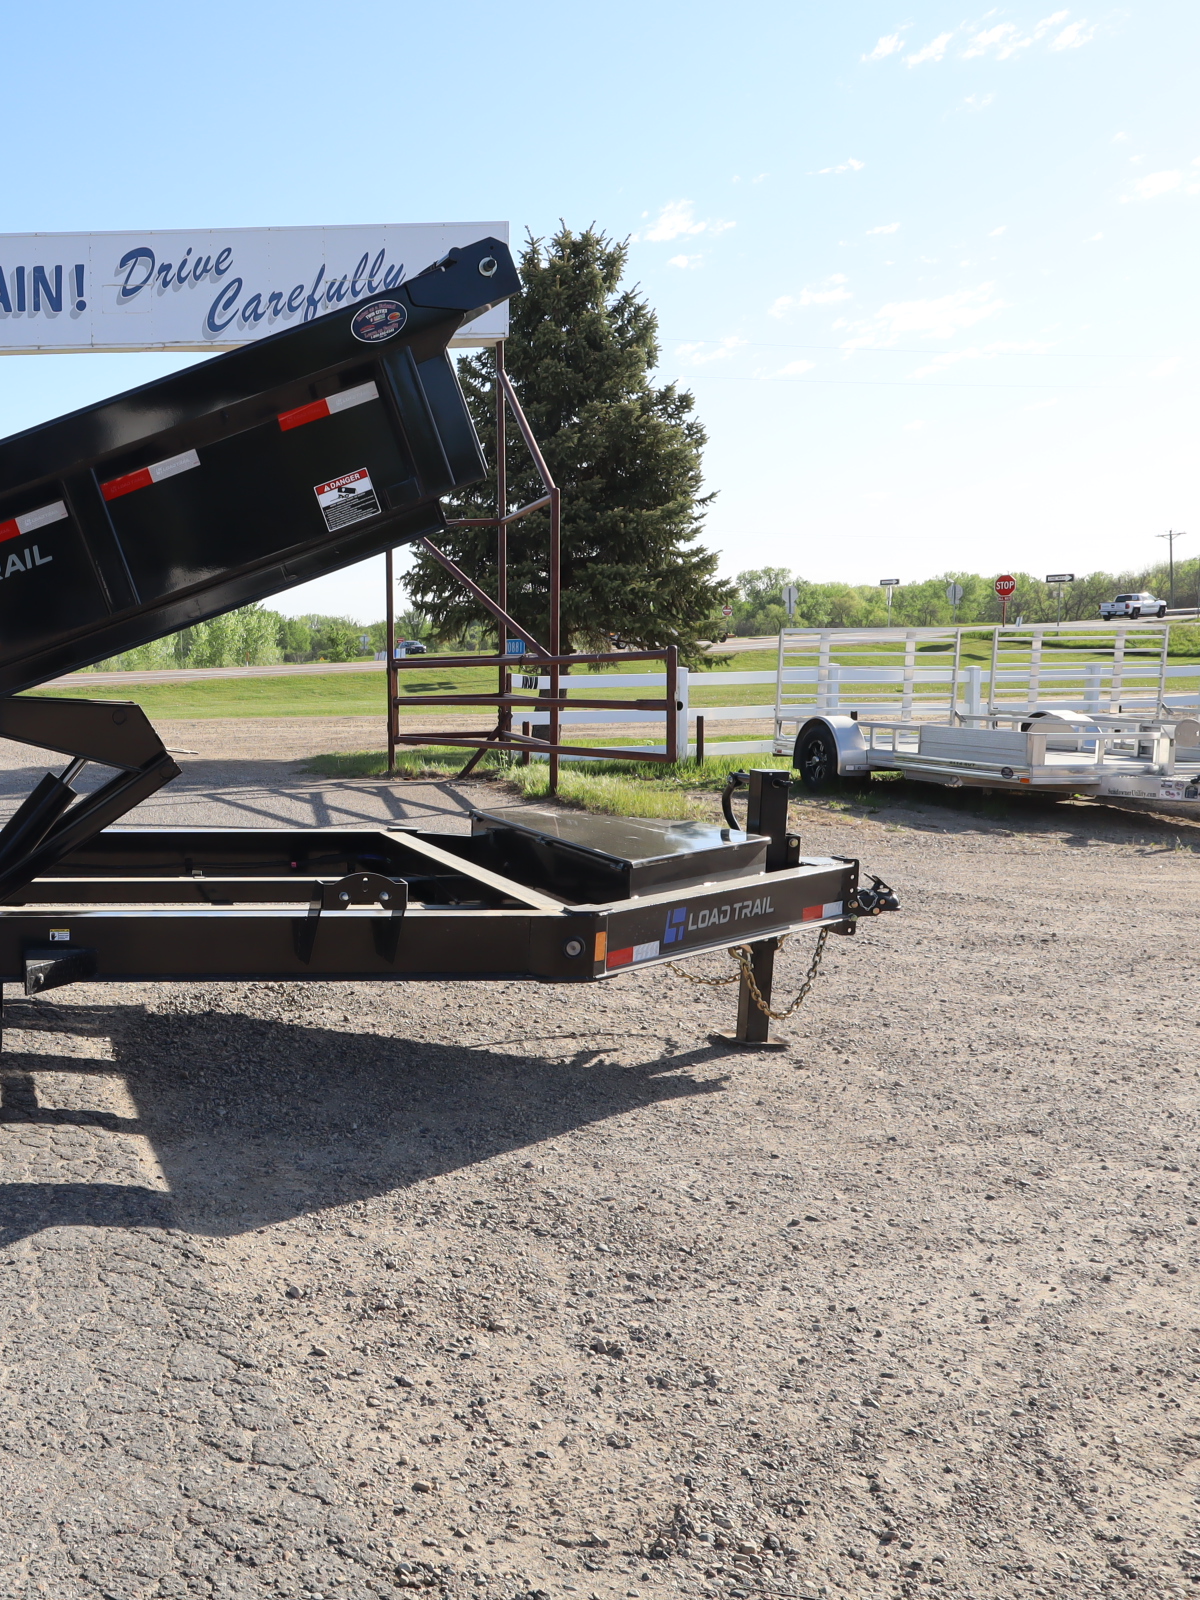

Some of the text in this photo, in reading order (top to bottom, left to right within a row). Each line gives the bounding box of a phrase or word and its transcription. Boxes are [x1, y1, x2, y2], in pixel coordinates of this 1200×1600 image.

[117, 246, 234, 299] Drive
[206, 247, 407, 333] Carefully
[329, 473, 361, 489] DANGER
[995, 581, 1015, 590] STOP
[688, 896, 775, 931] LOAD TRAIL
